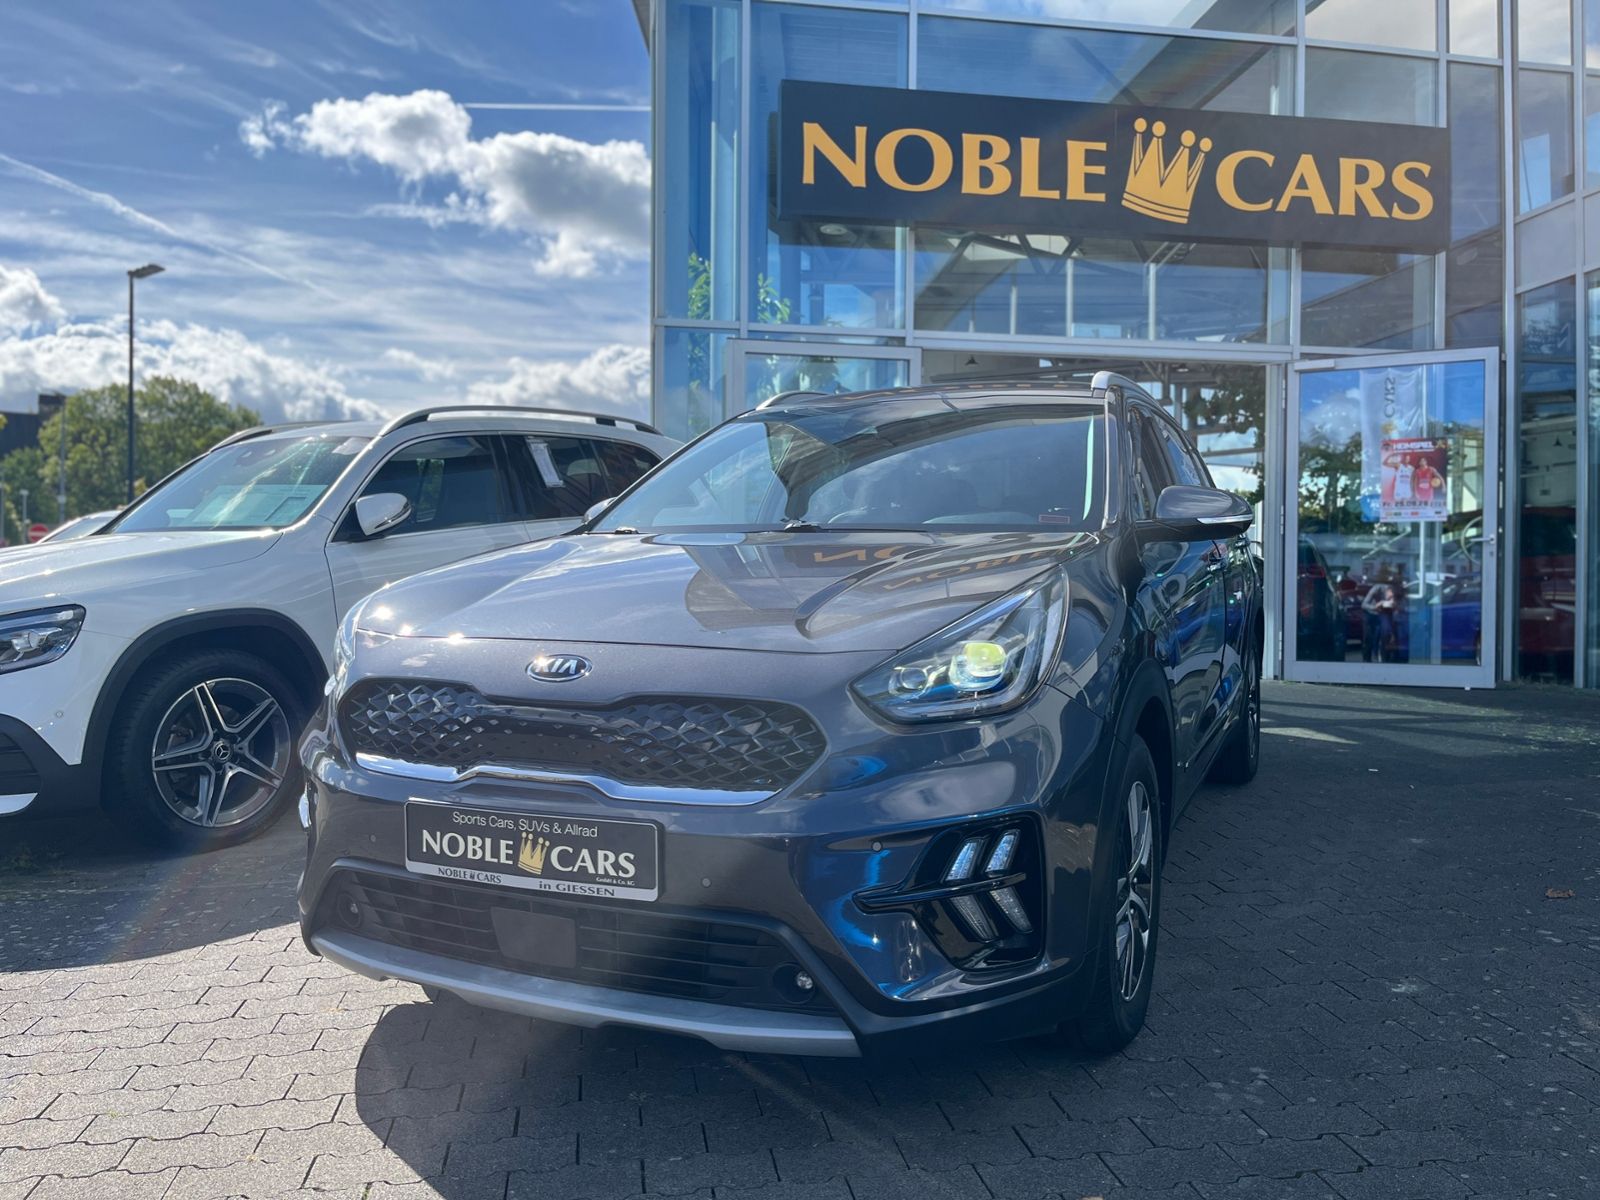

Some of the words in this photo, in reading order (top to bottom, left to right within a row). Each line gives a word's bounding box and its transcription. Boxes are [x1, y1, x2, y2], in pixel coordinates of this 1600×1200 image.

[803, 122, 1107, 202] NOBLE
[1215, 150, 1434, 221] CARS
[535, 658, 577, 674] KIA
[453, 811, 487, 826] Sports
[489, 816, 517, 831] Cars,
[519, 818, 551, 833] SUVs
[553, 822, 562, 834] &
[564, 823, 598, 838] Allrad
[422, 829, 514, 865] NOBLE
[550, 845, 636, 878] CARS
[438, 867, 468, 880] NOBLE
[477, 872, 502, 884] CARS
[539, 881, 551, 890] in
[556, 883, 616, 897] GIESSEN
